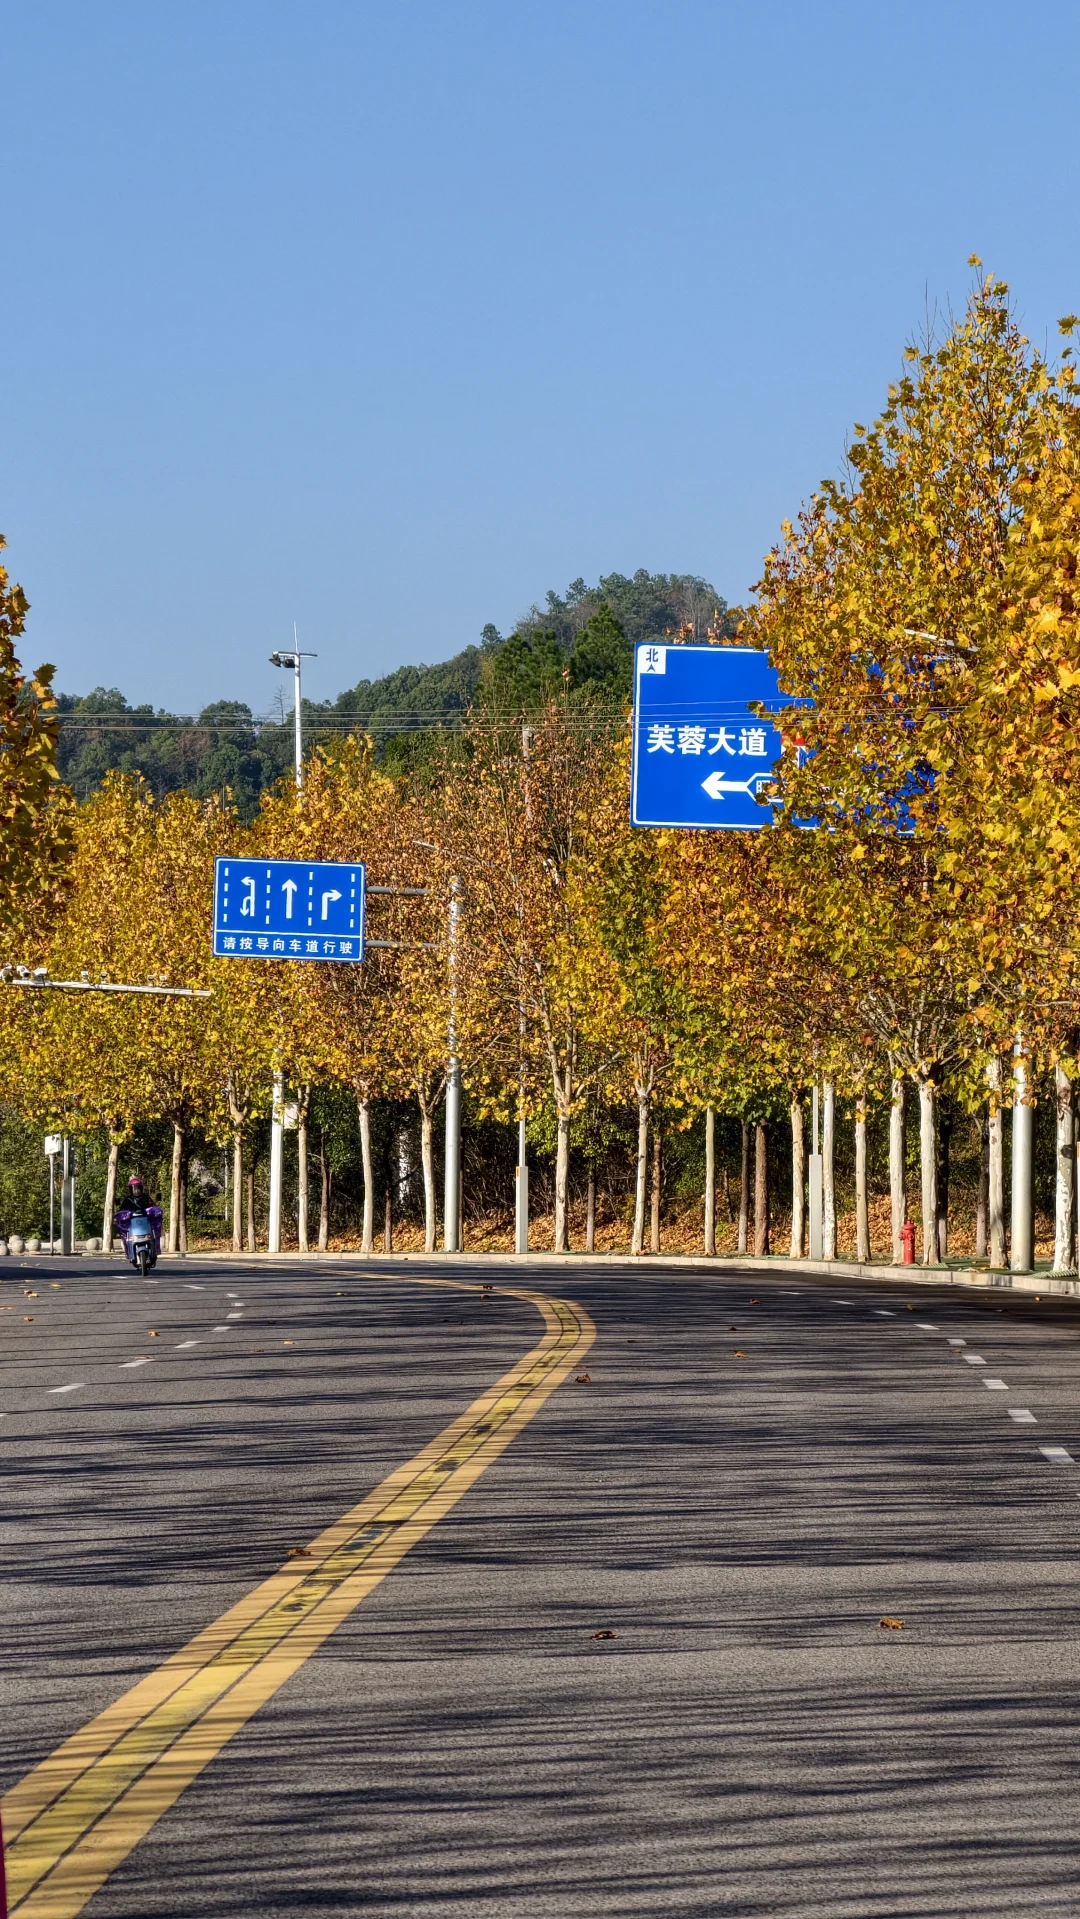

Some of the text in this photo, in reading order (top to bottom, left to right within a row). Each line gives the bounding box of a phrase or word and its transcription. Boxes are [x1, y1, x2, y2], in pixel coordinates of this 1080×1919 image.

[646, 648, 658, 662] 北
[647, 724, 768, 756] 芙蓉大道
[223, 936, 353, 954] 请按导向车道行驶
